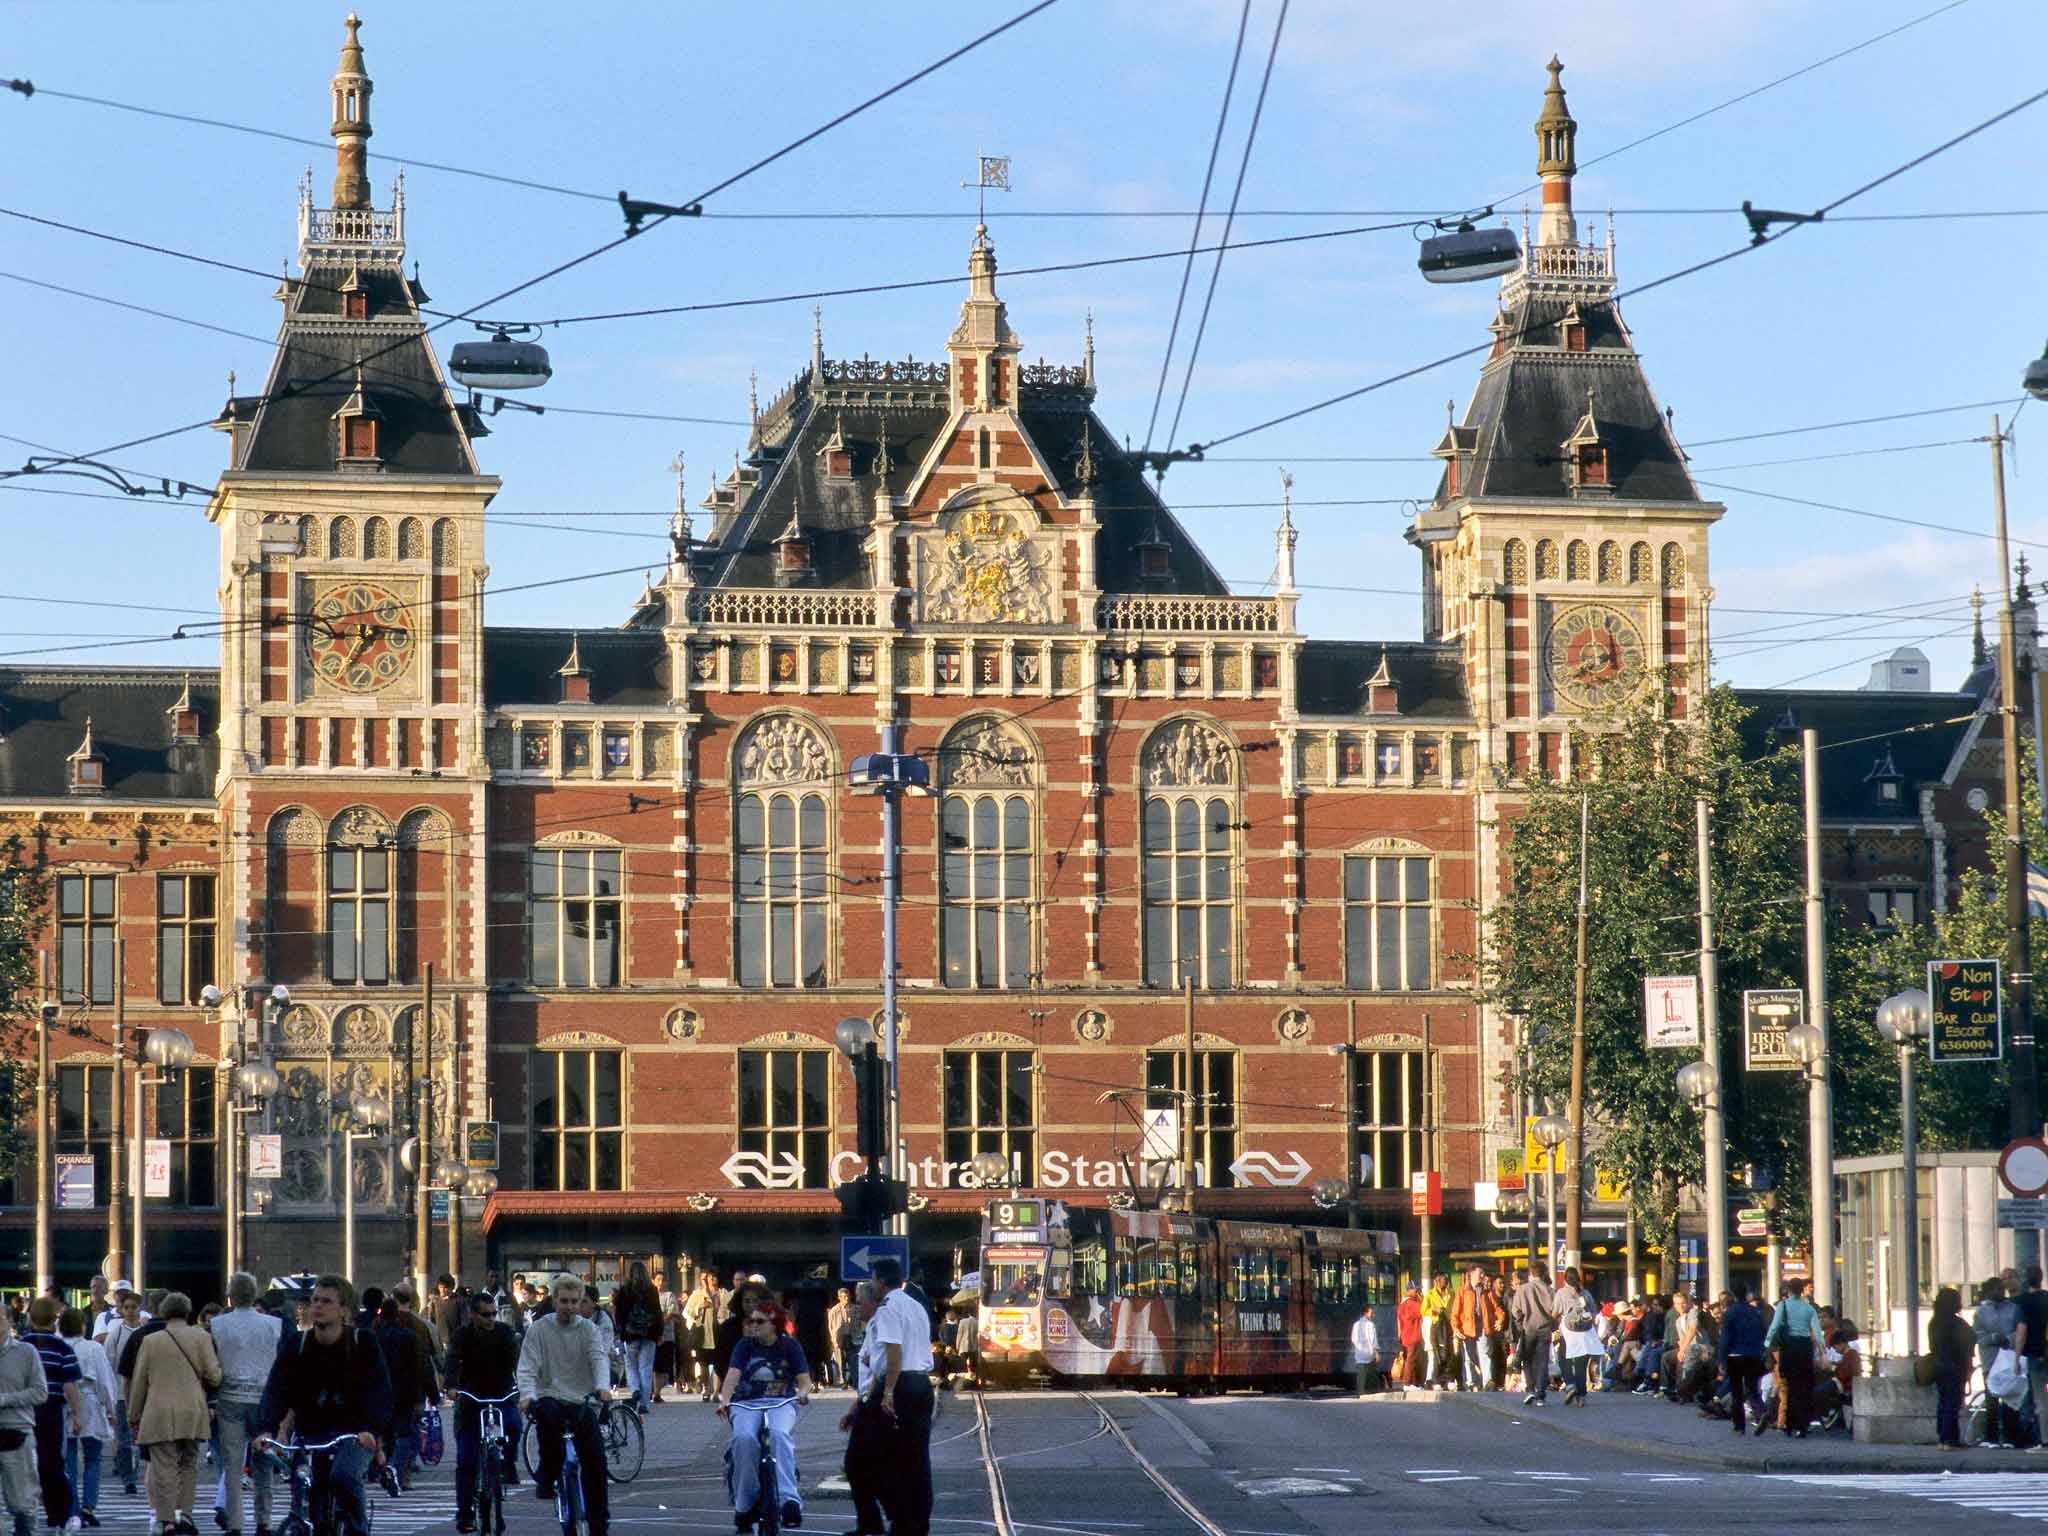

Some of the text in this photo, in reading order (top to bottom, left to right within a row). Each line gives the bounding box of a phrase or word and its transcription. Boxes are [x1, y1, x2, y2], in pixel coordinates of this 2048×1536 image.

[351, 591, 368, 609] N
[1963, 967, 1993, 983] Non
[57, 1156, 93, 1165] CHANGE
[831, 1150, 1021, 1189] Ctral
[999, 1203, 1014, 1225] 9
[1239, 1311, 1281, 1332] THINK BIG
[996, 1326, 1025, 1336] KG
